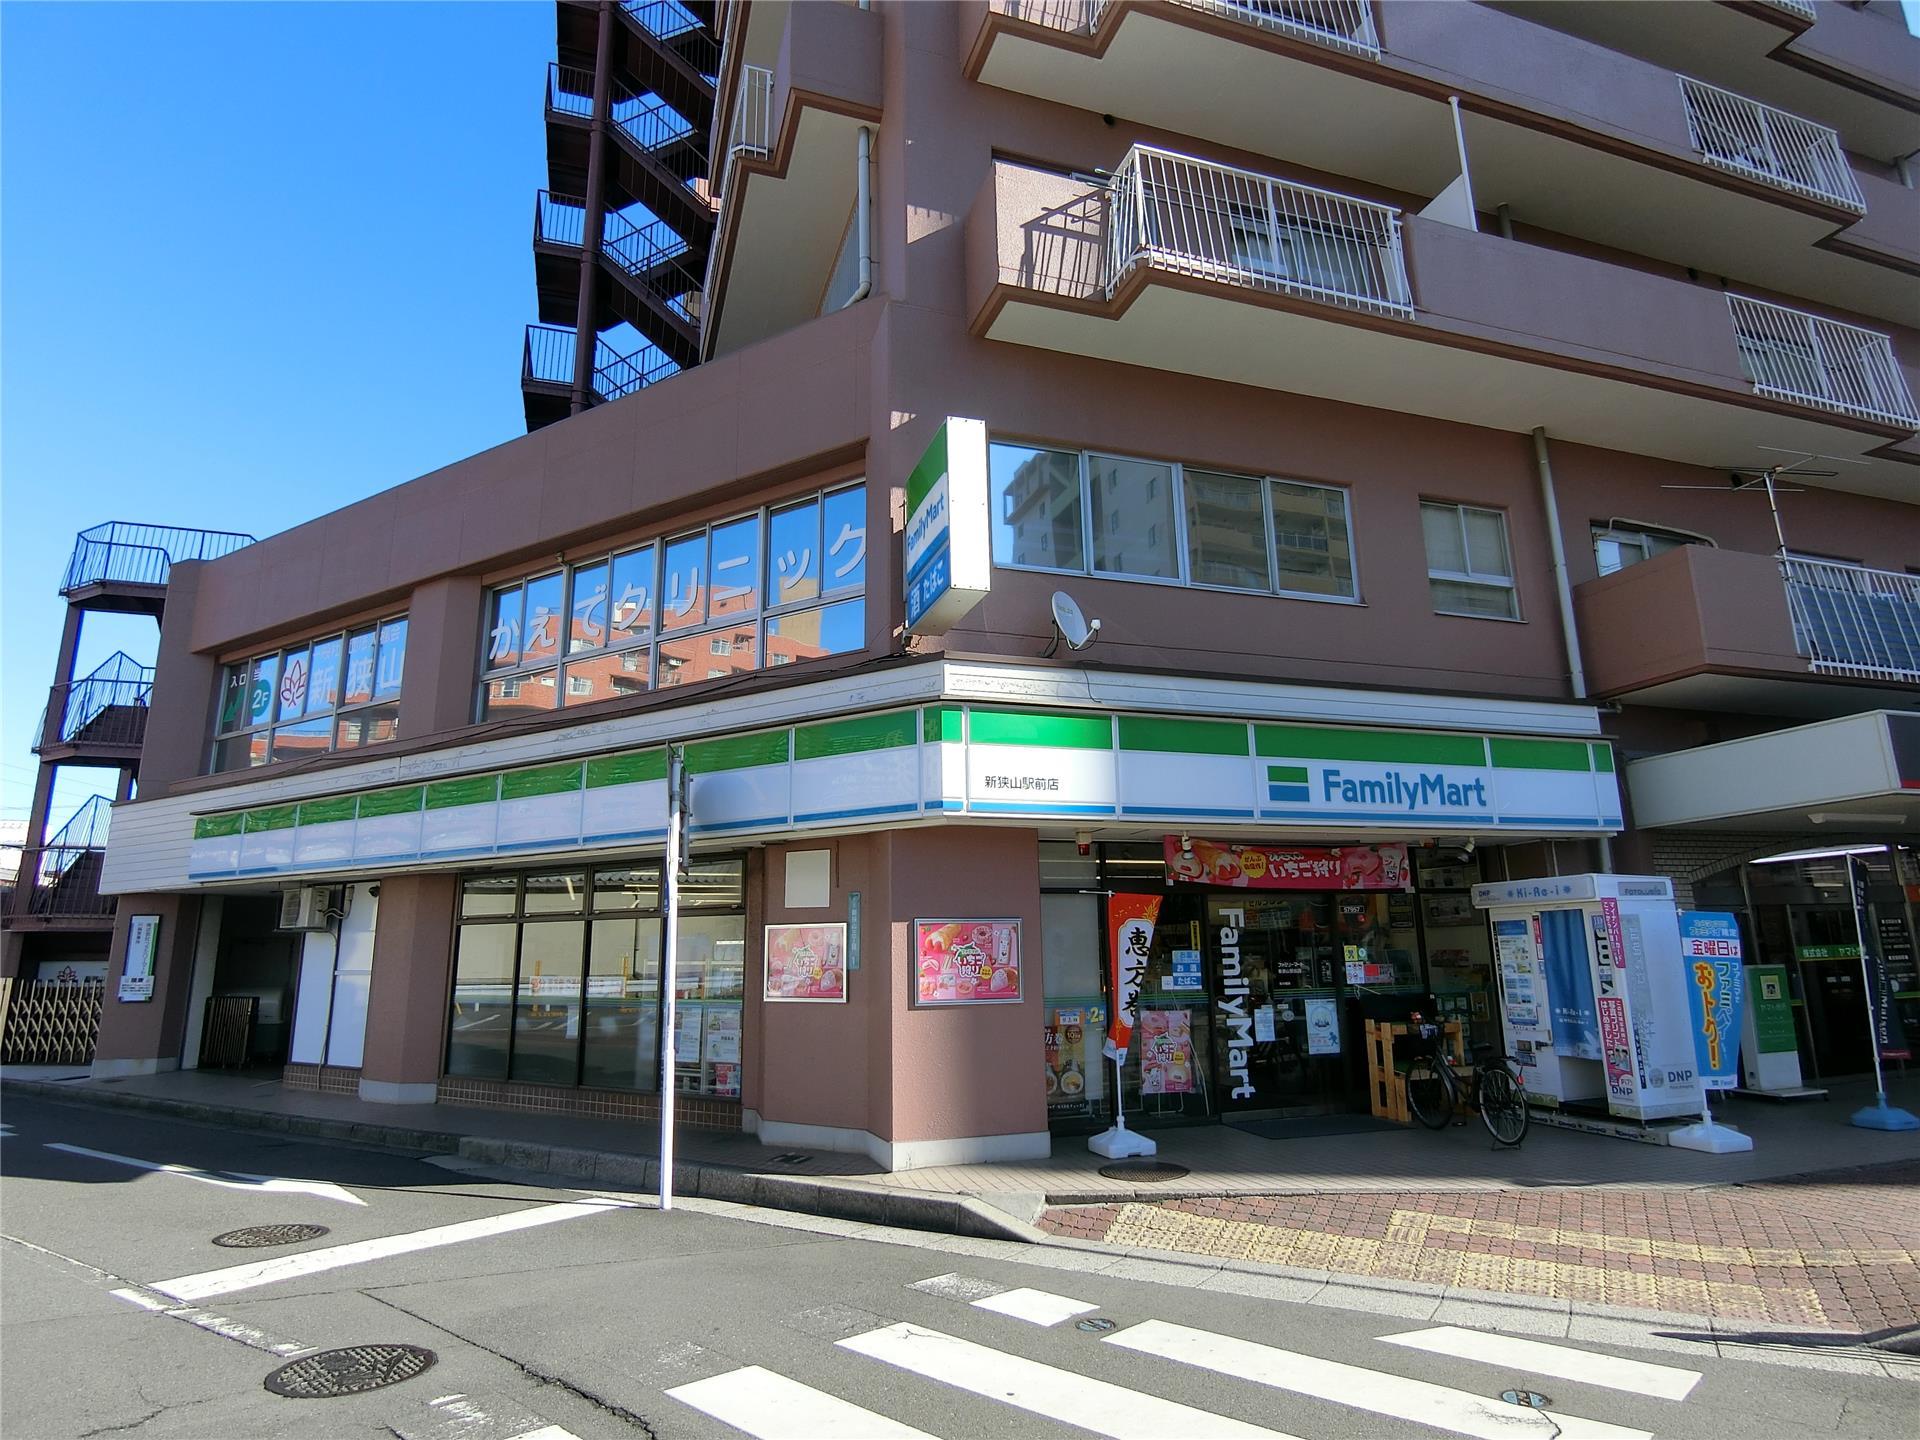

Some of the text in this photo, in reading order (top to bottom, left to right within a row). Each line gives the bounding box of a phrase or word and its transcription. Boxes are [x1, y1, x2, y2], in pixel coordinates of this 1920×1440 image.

[906, 491, 945, 558] FamilyMart
[489, 522, 866, 660] かえでクリニック
[910, 560, 945, 619] 酒 たばこ
[230, 673, 247, 688] 入口
[310, 648, 404, 704] 新狭山
[252, 689, 269, 709] 2F
[984, 775, 1060, 791] 新狭山駅前店
[1322, 768, 1487, 810] FamilyMart
[1269, 859, 1341, 878] いちご狩り
[1691, 939, 1739, 956] 金曜日は
[957, 954, 985, 965] いちご
[961, 965, 980, 976] 狩り
[1121, 927, 1149, 1017] 恵方巻
[1177, 976, 1198, 985] たばこ
[1218, 908, 1257, 1099] FamilyMart
[1667, 1070, 1693, 1083] DNP
[1612, 1086, 1633, 1096] DNP
